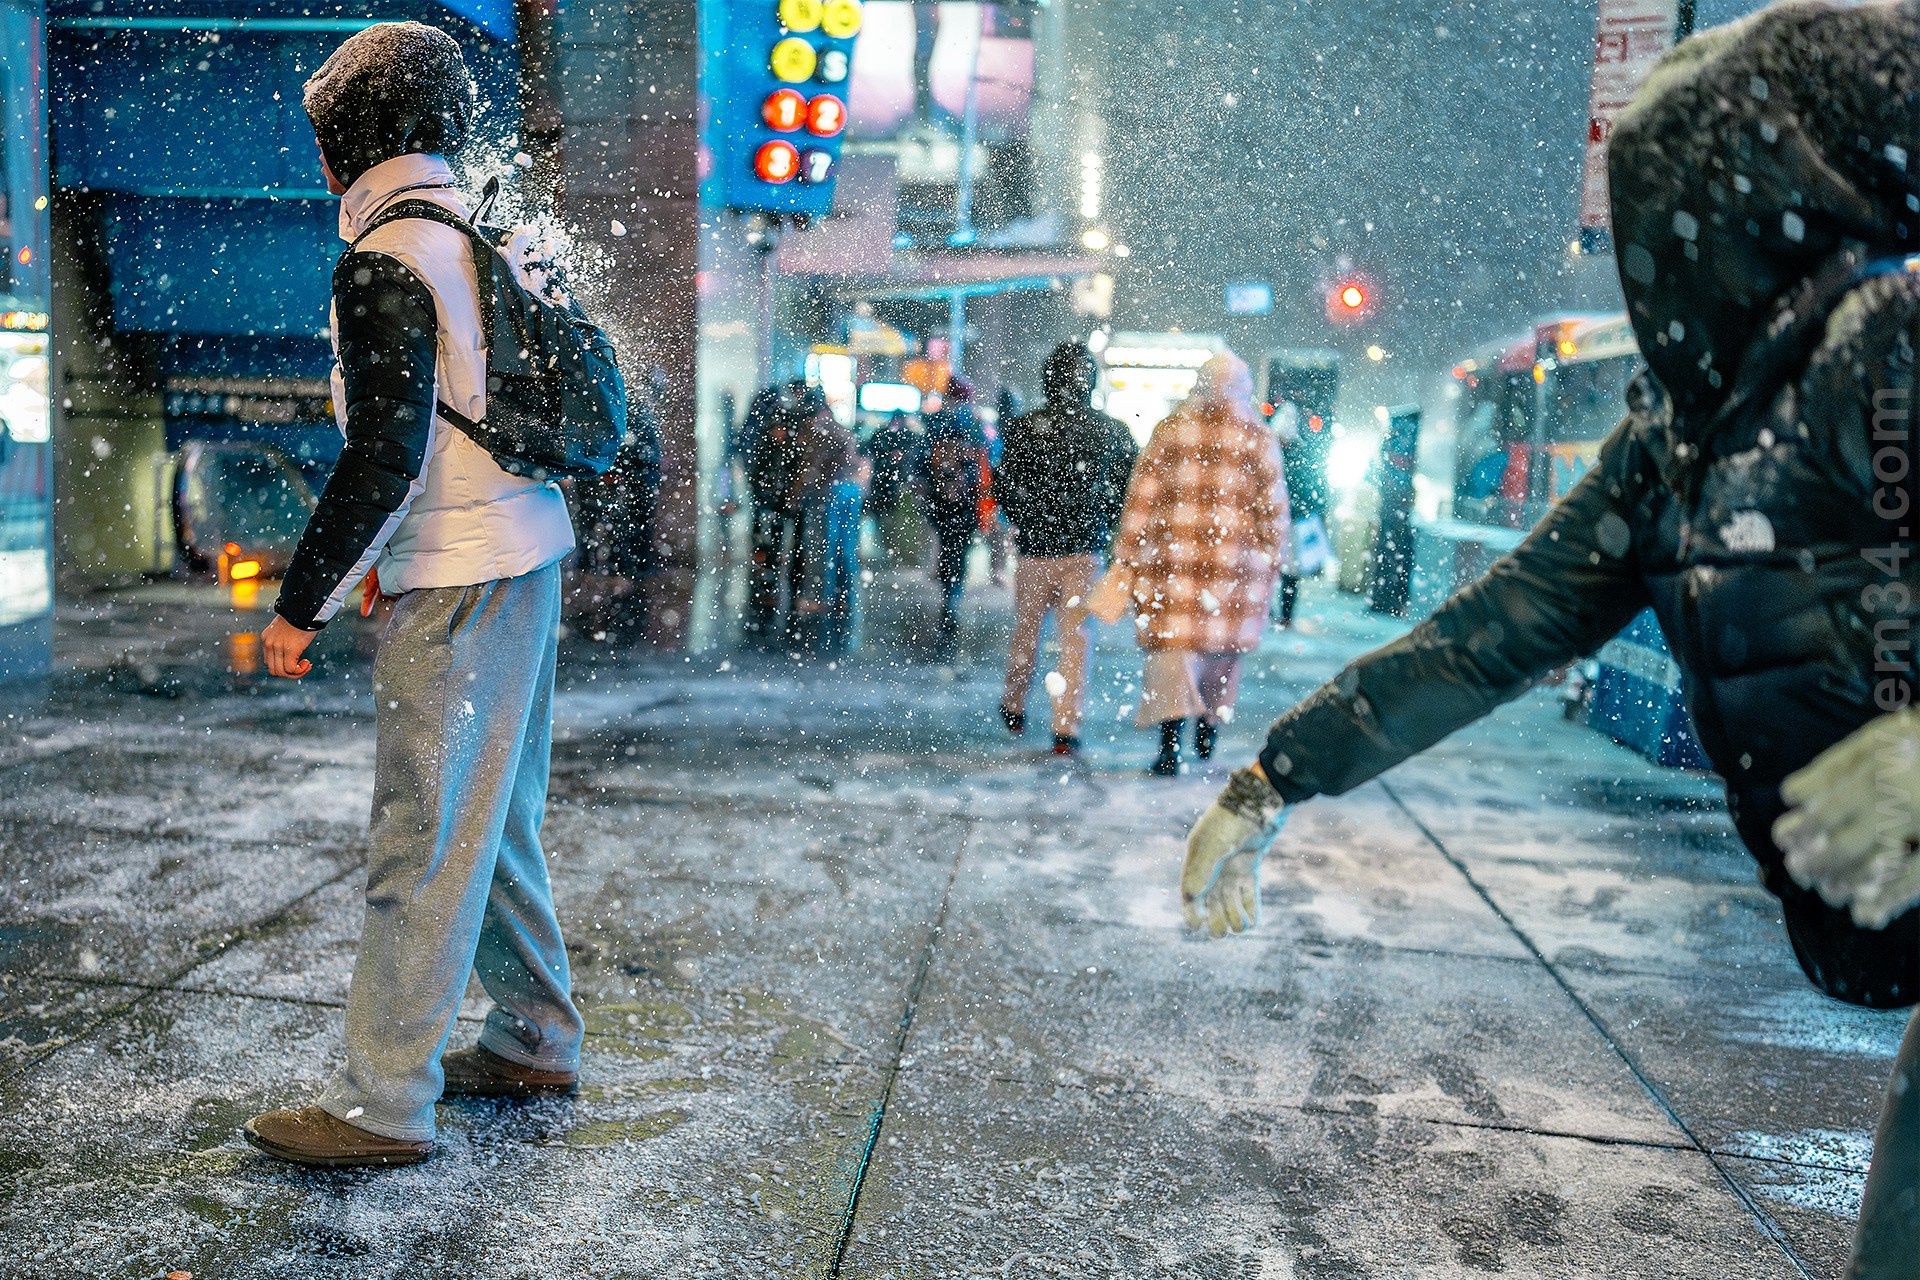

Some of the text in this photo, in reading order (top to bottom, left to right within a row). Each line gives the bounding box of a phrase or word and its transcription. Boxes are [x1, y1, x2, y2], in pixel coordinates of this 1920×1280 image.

[822, 51, 847, 82] S
[780, 97, 839, 130] 1 2
[768, 147, 832, 182] 3 7
